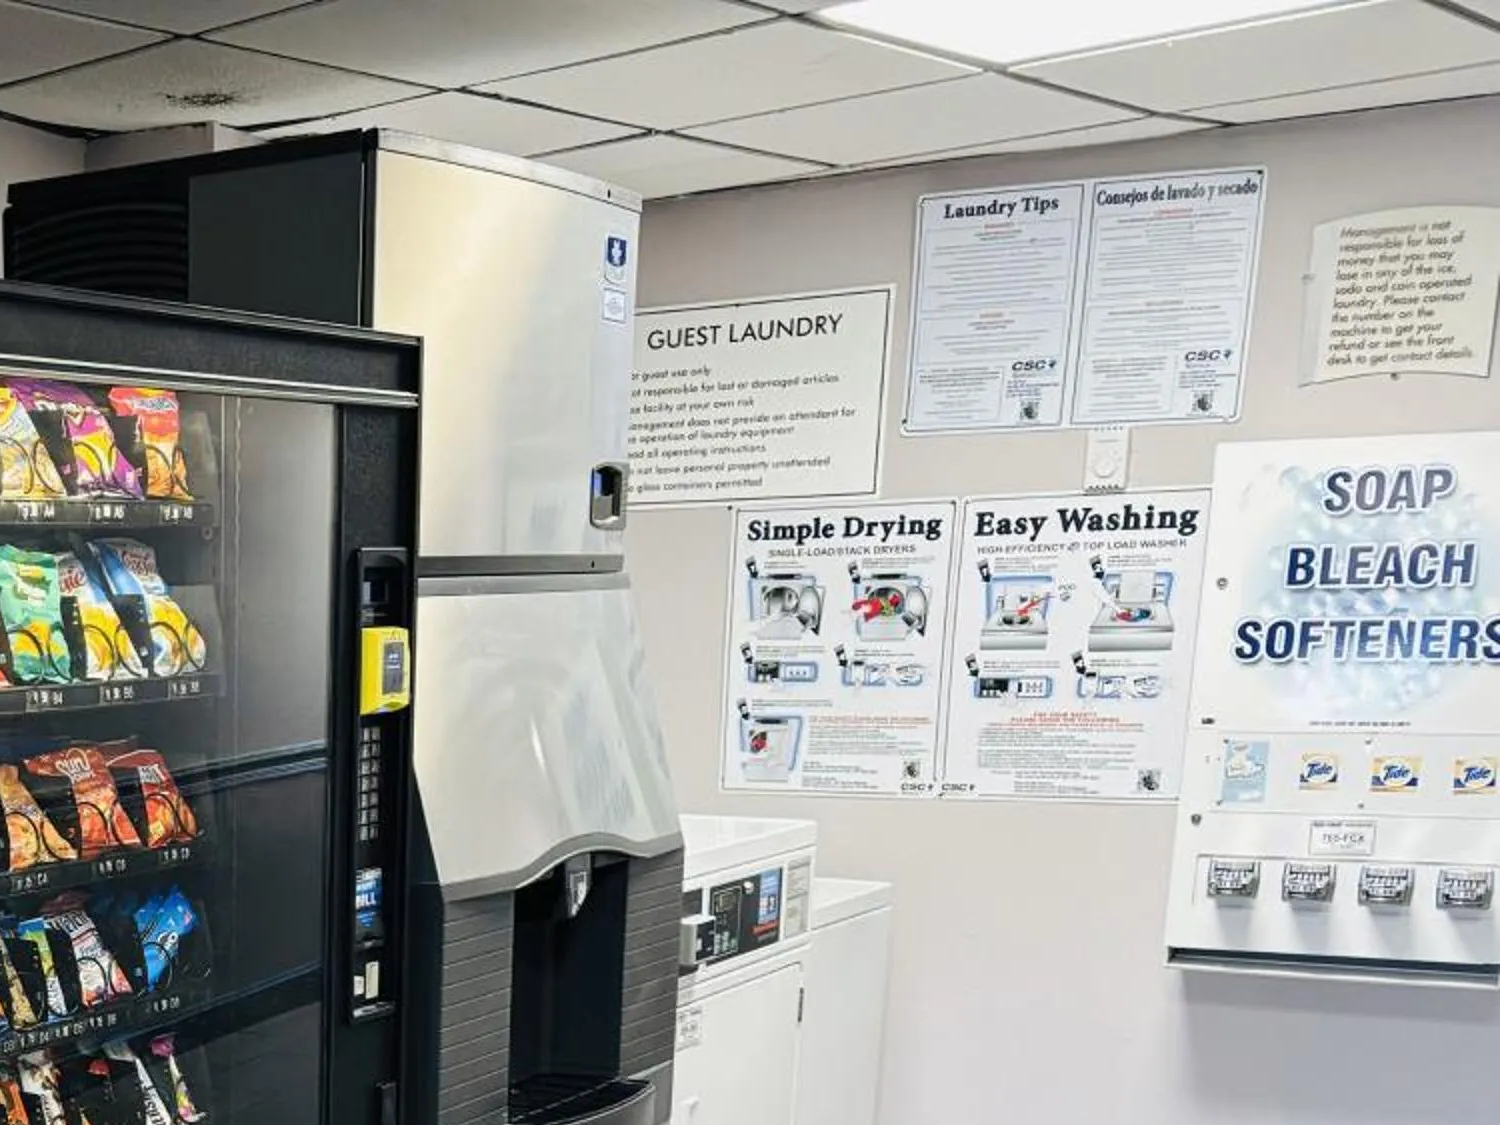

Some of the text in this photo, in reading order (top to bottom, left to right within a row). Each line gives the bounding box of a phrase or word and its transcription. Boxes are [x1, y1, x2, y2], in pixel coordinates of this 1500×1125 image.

[1097, 179, 1258, 207] Consejos de lavado y secado
[943, 196, 1059, 219] Laundry Tips
[1340, 223, 1417, 238] Management
[1432, 220, 1451, 230] not
[1339, 230, 1466, 253] responsible for loss of
[1337, 250, 1456, 267] money that you may
[1336, 270, 1359, 281] lose
[1361, 270, 1373, 279] in
[1375, 269, 1398, 279] any
[1400, 265, 1414, 277] of
[1415, 265, 1433, 275] the
[1335, 274, 1473, 296] soda and coin operated
[1383, 294, 1420, 306] Please
[1422, 292, 1466, 304] contact
[1331, 307, 1435, 323] the number on the
[647, 313, 843, 350] GUEST LAUNDRY
[1330, 323, 1443, 337] machine to get your
[1328, 334, 1455, 352] refund or see the front
[1185, 350, 1221, 361] CSC
[1327, 355, 1351, 366] desk
[1355, 355, 1366, 364] to
[1369, 354, 1389, 366] get
[1391, 351, 1433, 363] contact
[642, 364, 711, 382] guest use only
[1011, 360, 1047, 371] CSC
[643, 383, 699, 398] responsible
[701, 381, 715, 393] for
[717, 380, 735, 391] lost
[738, 380, 748, 389] or
[751, 376, 799, 390] damaged
[802, 373, 839, 385] articles
[643, 398, 754, 414] facility at your own risk
[628, 406, 856, 432] anagement does not provide an attendant for
[639, 425, 794, 445] operation of laundry equipment
[661, 446, 707, 460] operating
[710, 444, 767, 456] instructions
[655, 463, 680, 474] leave
[683, 461, 725, 475] personal
[727, 460, 768, 474] property
[772, 456, 831, 469] unattended
[637, 480, 661, 494] glass
[715, 477, 763, 490] permitted
[1322, 467, 1455, 513] SOAP
[747, 514, 943, 545] Simple Drying
[974, 503, 1200, 542] Easy Washing
[1107, 540, 1137, 550] LOAD
[1284, 542, 1477, 588] BLEACH
[1233, 617, 1500, 661] SOFTENERS
[1306, 762, 1333, 778] Tide
[1383, 766, 1410, 781] Tide
[1463, 767, 1491, 784] Tide
